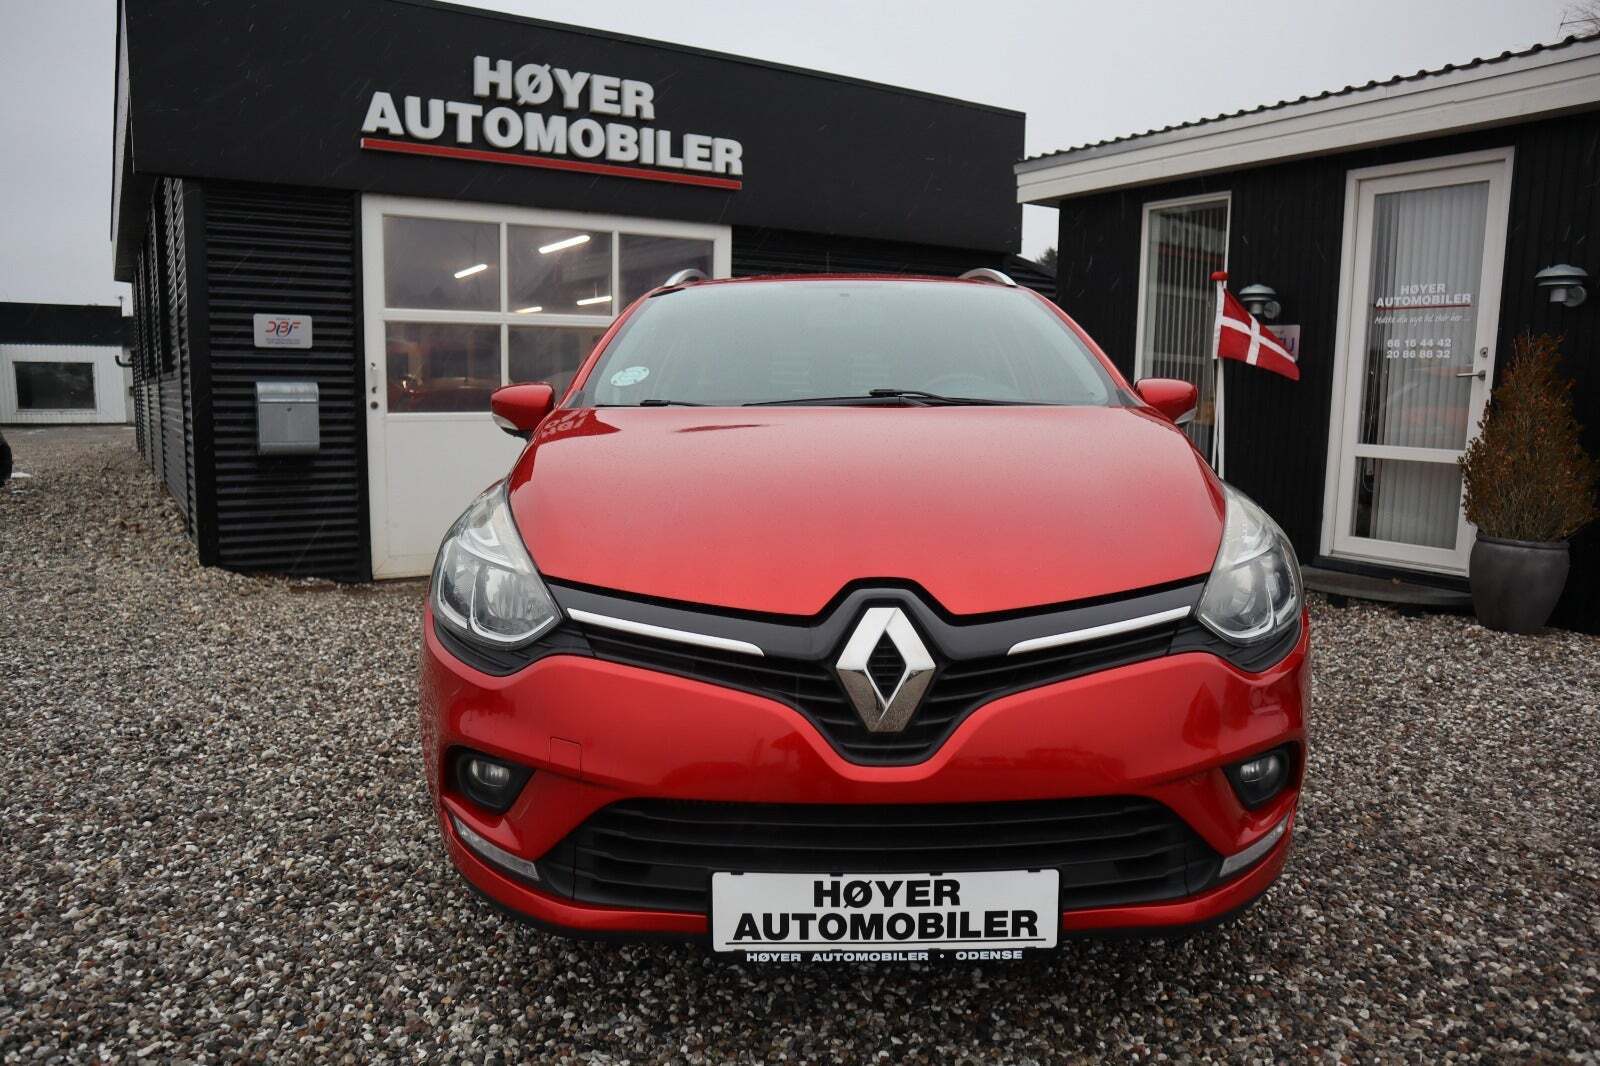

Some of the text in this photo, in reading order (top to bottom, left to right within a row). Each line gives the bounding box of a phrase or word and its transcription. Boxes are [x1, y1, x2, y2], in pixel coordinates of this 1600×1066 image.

[473, 55, 656, 120] HØYER
[361, 91, 744, 176] AUTOMOBILER
[1400, 283, 1446, 295] HØYER
[1375, 293, 1472, 308] AUTOMOBILER
[1420, 338, 1434, 347] 44
[1437, 338, 1452, 347] 42
[1386, 350, 1400, 359] 20
[1436, 350, 1450, 358] 32
[813, 879, 961, 909] HØYER
[732, 910, 1039, 941] AUTOMOBILER
[746, 950, 1023, 963] HØYER AUTOMOBILER ODENSE
